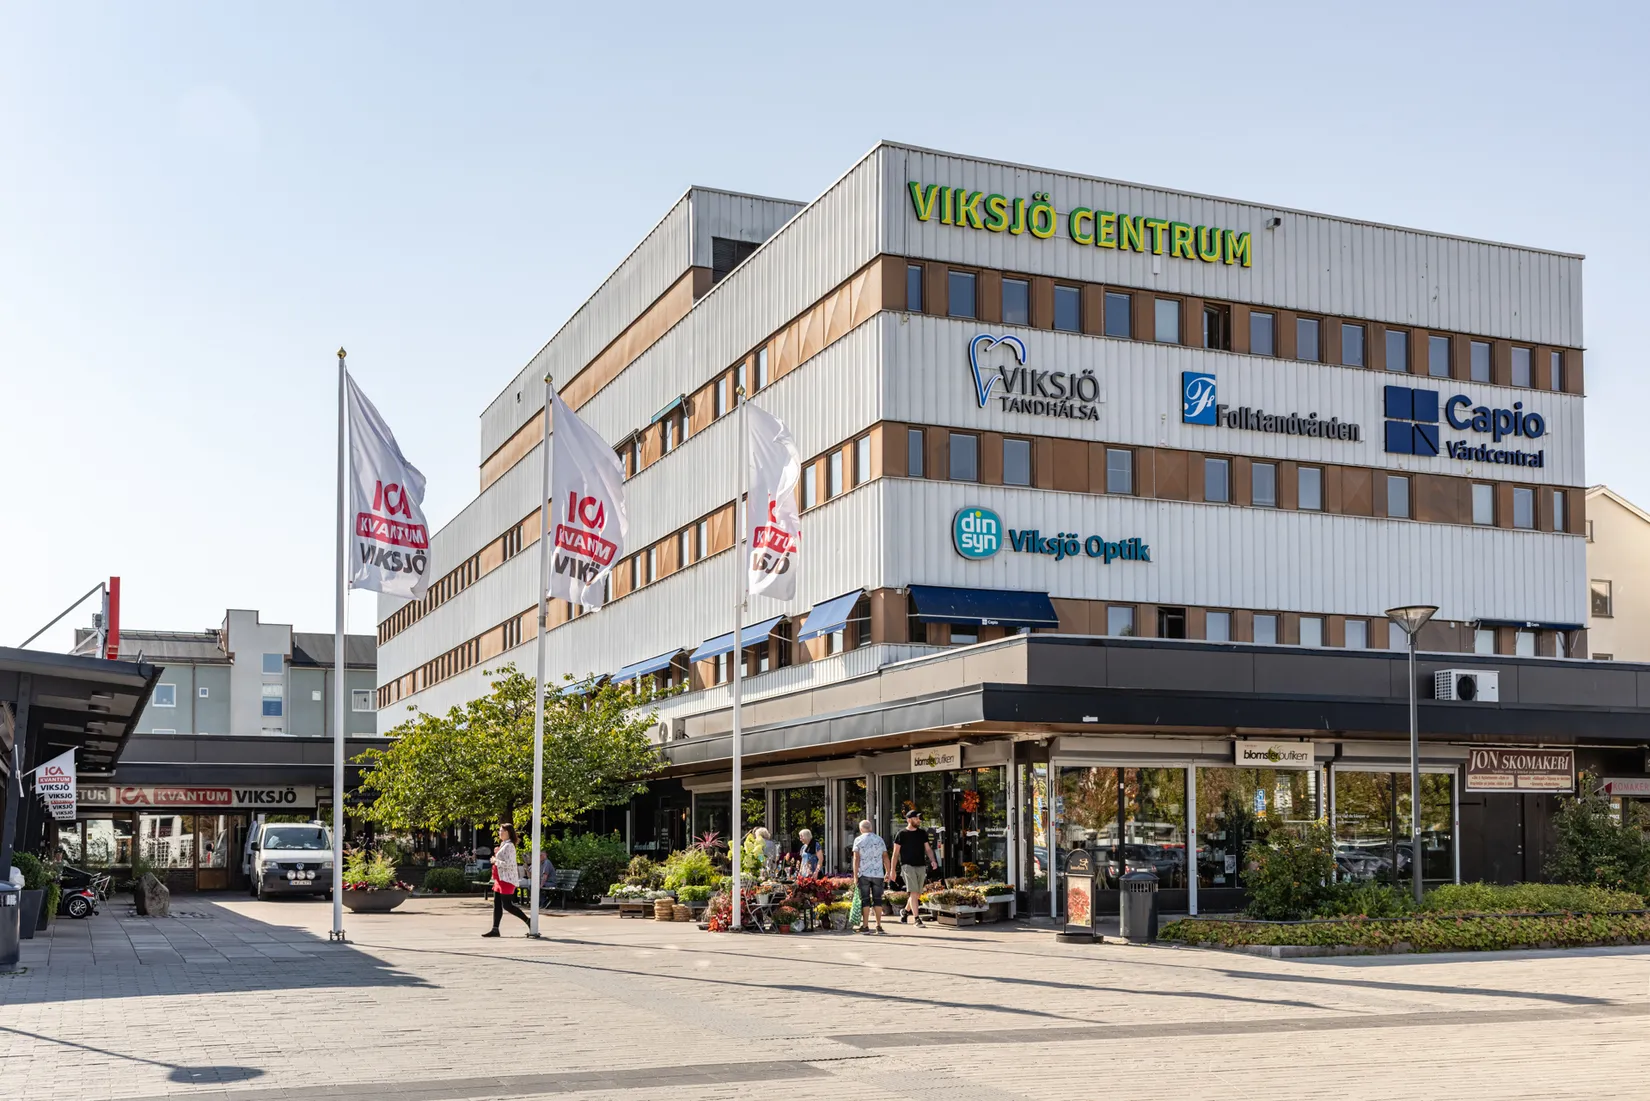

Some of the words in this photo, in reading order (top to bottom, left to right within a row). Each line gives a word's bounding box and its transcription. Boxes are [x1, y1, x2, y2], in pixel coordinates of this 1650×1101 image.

[908, 181, 1057, 239] VIKSJÖ
[1069, 206, 1252, 268] CENTRUM
[999, 365, 1100, 402] VIKSJÖ
[999, 396, 1100, 421] TANDHÄLSA
[1445, 394, 1545, 443] Capio
[1216, 404, 1360, 441] Folktandvården
[1445, 440, 1544, 468] Vårdcentral
[373, 480, 412, 519] ICA
[361, 518, 425, 544] KVANTUM
[961, 511, 996, 534] din
[961, 534, 997, 553] syn
[1009, 529, 1081, 561] Viksjö
[1085, 535, 1151, 564] Optik
[360, 542, 427, 575] VIKSJÖ
[45, 766, 64, 776] ICA
[1470, 750, 1500, 771] JON
[1501, 755, 1570, 770] SKOMAKERI
[40, 783, 70, 791] VIKSJÖ
[115, 787, 151, 805] ICA
[157, 790, 228, 802] KVANTUM
[235, 788, 297, 804] VIKSJÖ
[1613, 781, 1650, 792] KOMAKER
